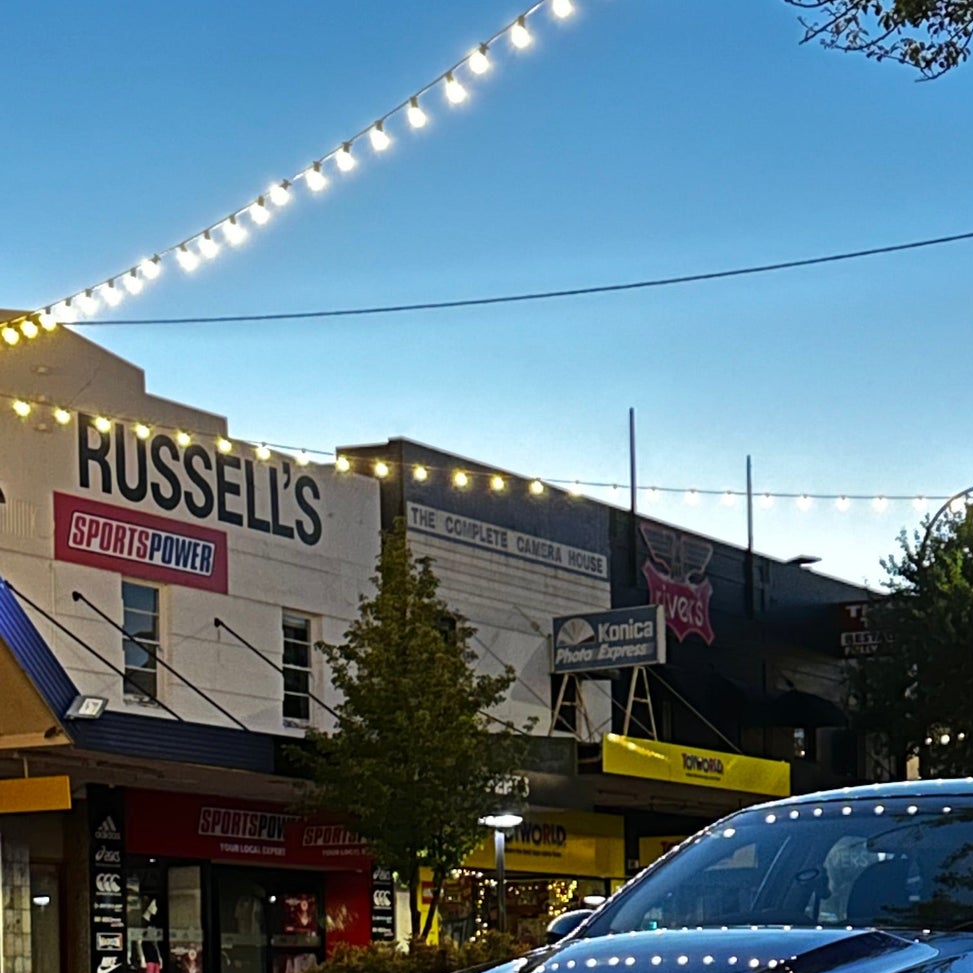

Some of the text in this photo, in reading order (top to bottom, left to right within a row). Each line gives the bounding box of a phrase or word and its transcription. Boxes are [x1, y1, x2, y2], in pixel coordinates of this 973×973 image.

[78, 413, 322, 546] RUSSELL'S
[72, 515, 213, 575] SPORTSPOWER
[411, 507, 603, 574] THE COMPLETE CAMERA HOUSE
[555, 643, 649, 664] Photo Express
[598, 618, 654, 643] Konica
